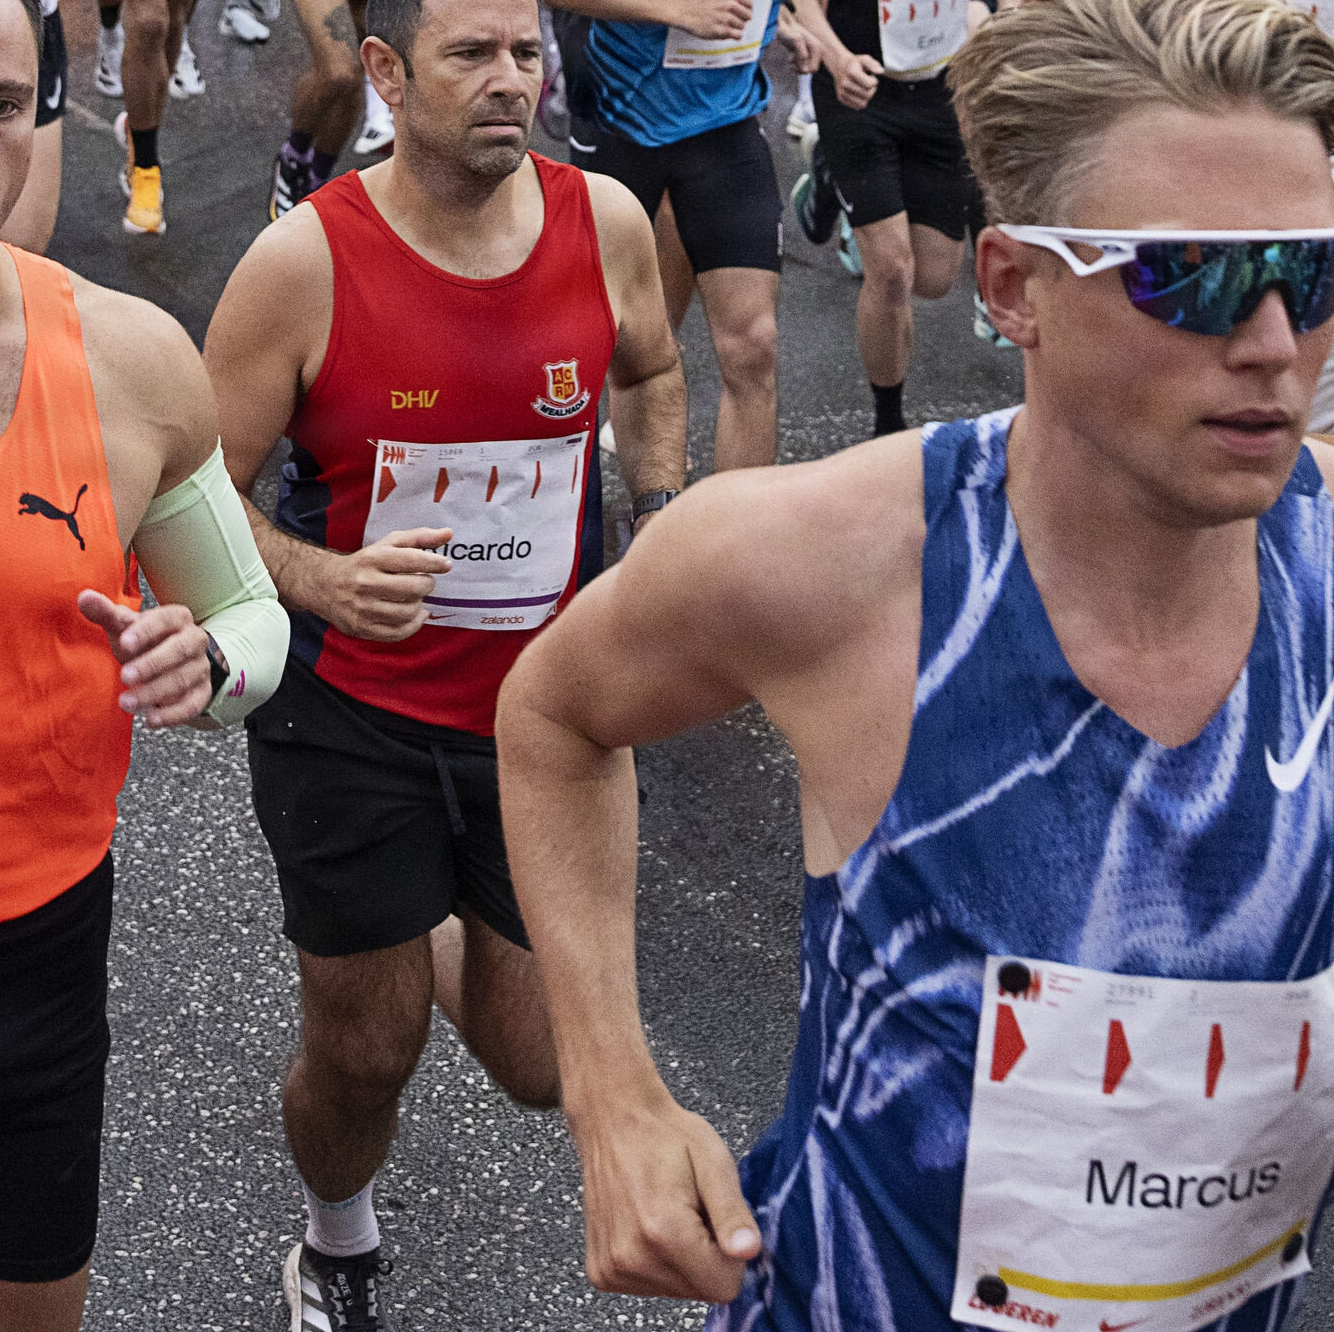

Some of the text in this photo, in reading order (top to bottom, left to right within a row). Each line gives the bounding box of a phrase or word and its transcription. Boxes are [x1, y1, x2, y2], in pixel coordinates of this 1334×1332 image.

[389, 389, 440, 410] DHV
[539, 399, 586, 417] MEALHADA
[480, 615, 525, 625] zalando
[1085, 1158, 1282, 1210] Marcus
